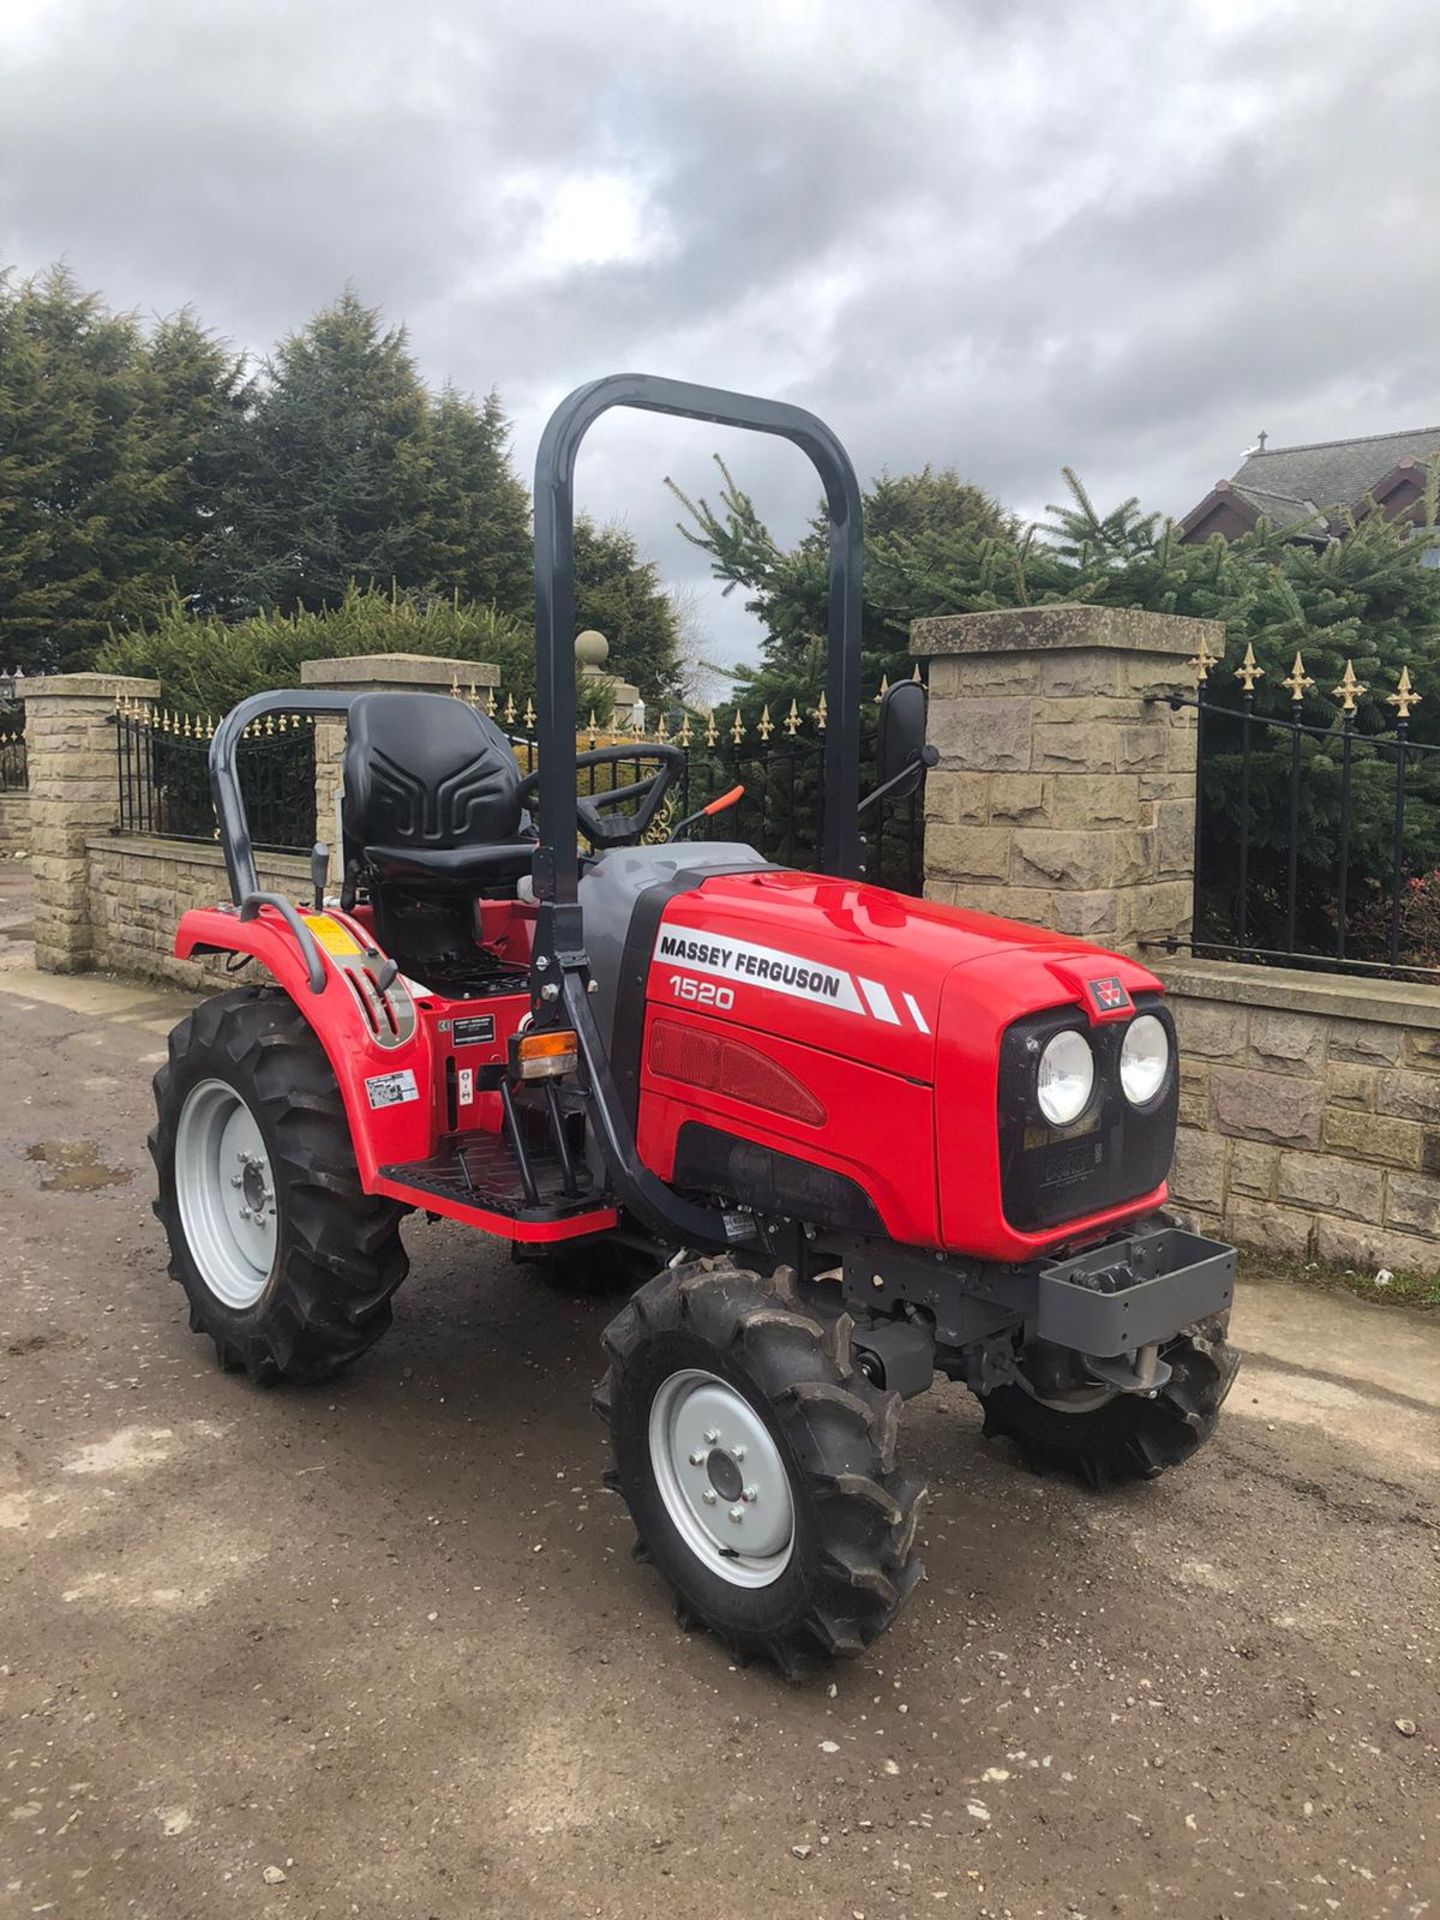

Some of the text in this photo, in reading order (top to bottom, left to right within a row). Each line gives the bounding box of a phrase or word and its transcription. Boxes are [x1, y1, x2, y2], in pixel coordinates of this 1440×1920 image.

[661, 936, 840, 997] MASSEY FERGUSON
[669, 975, 734, 1011] 1520
